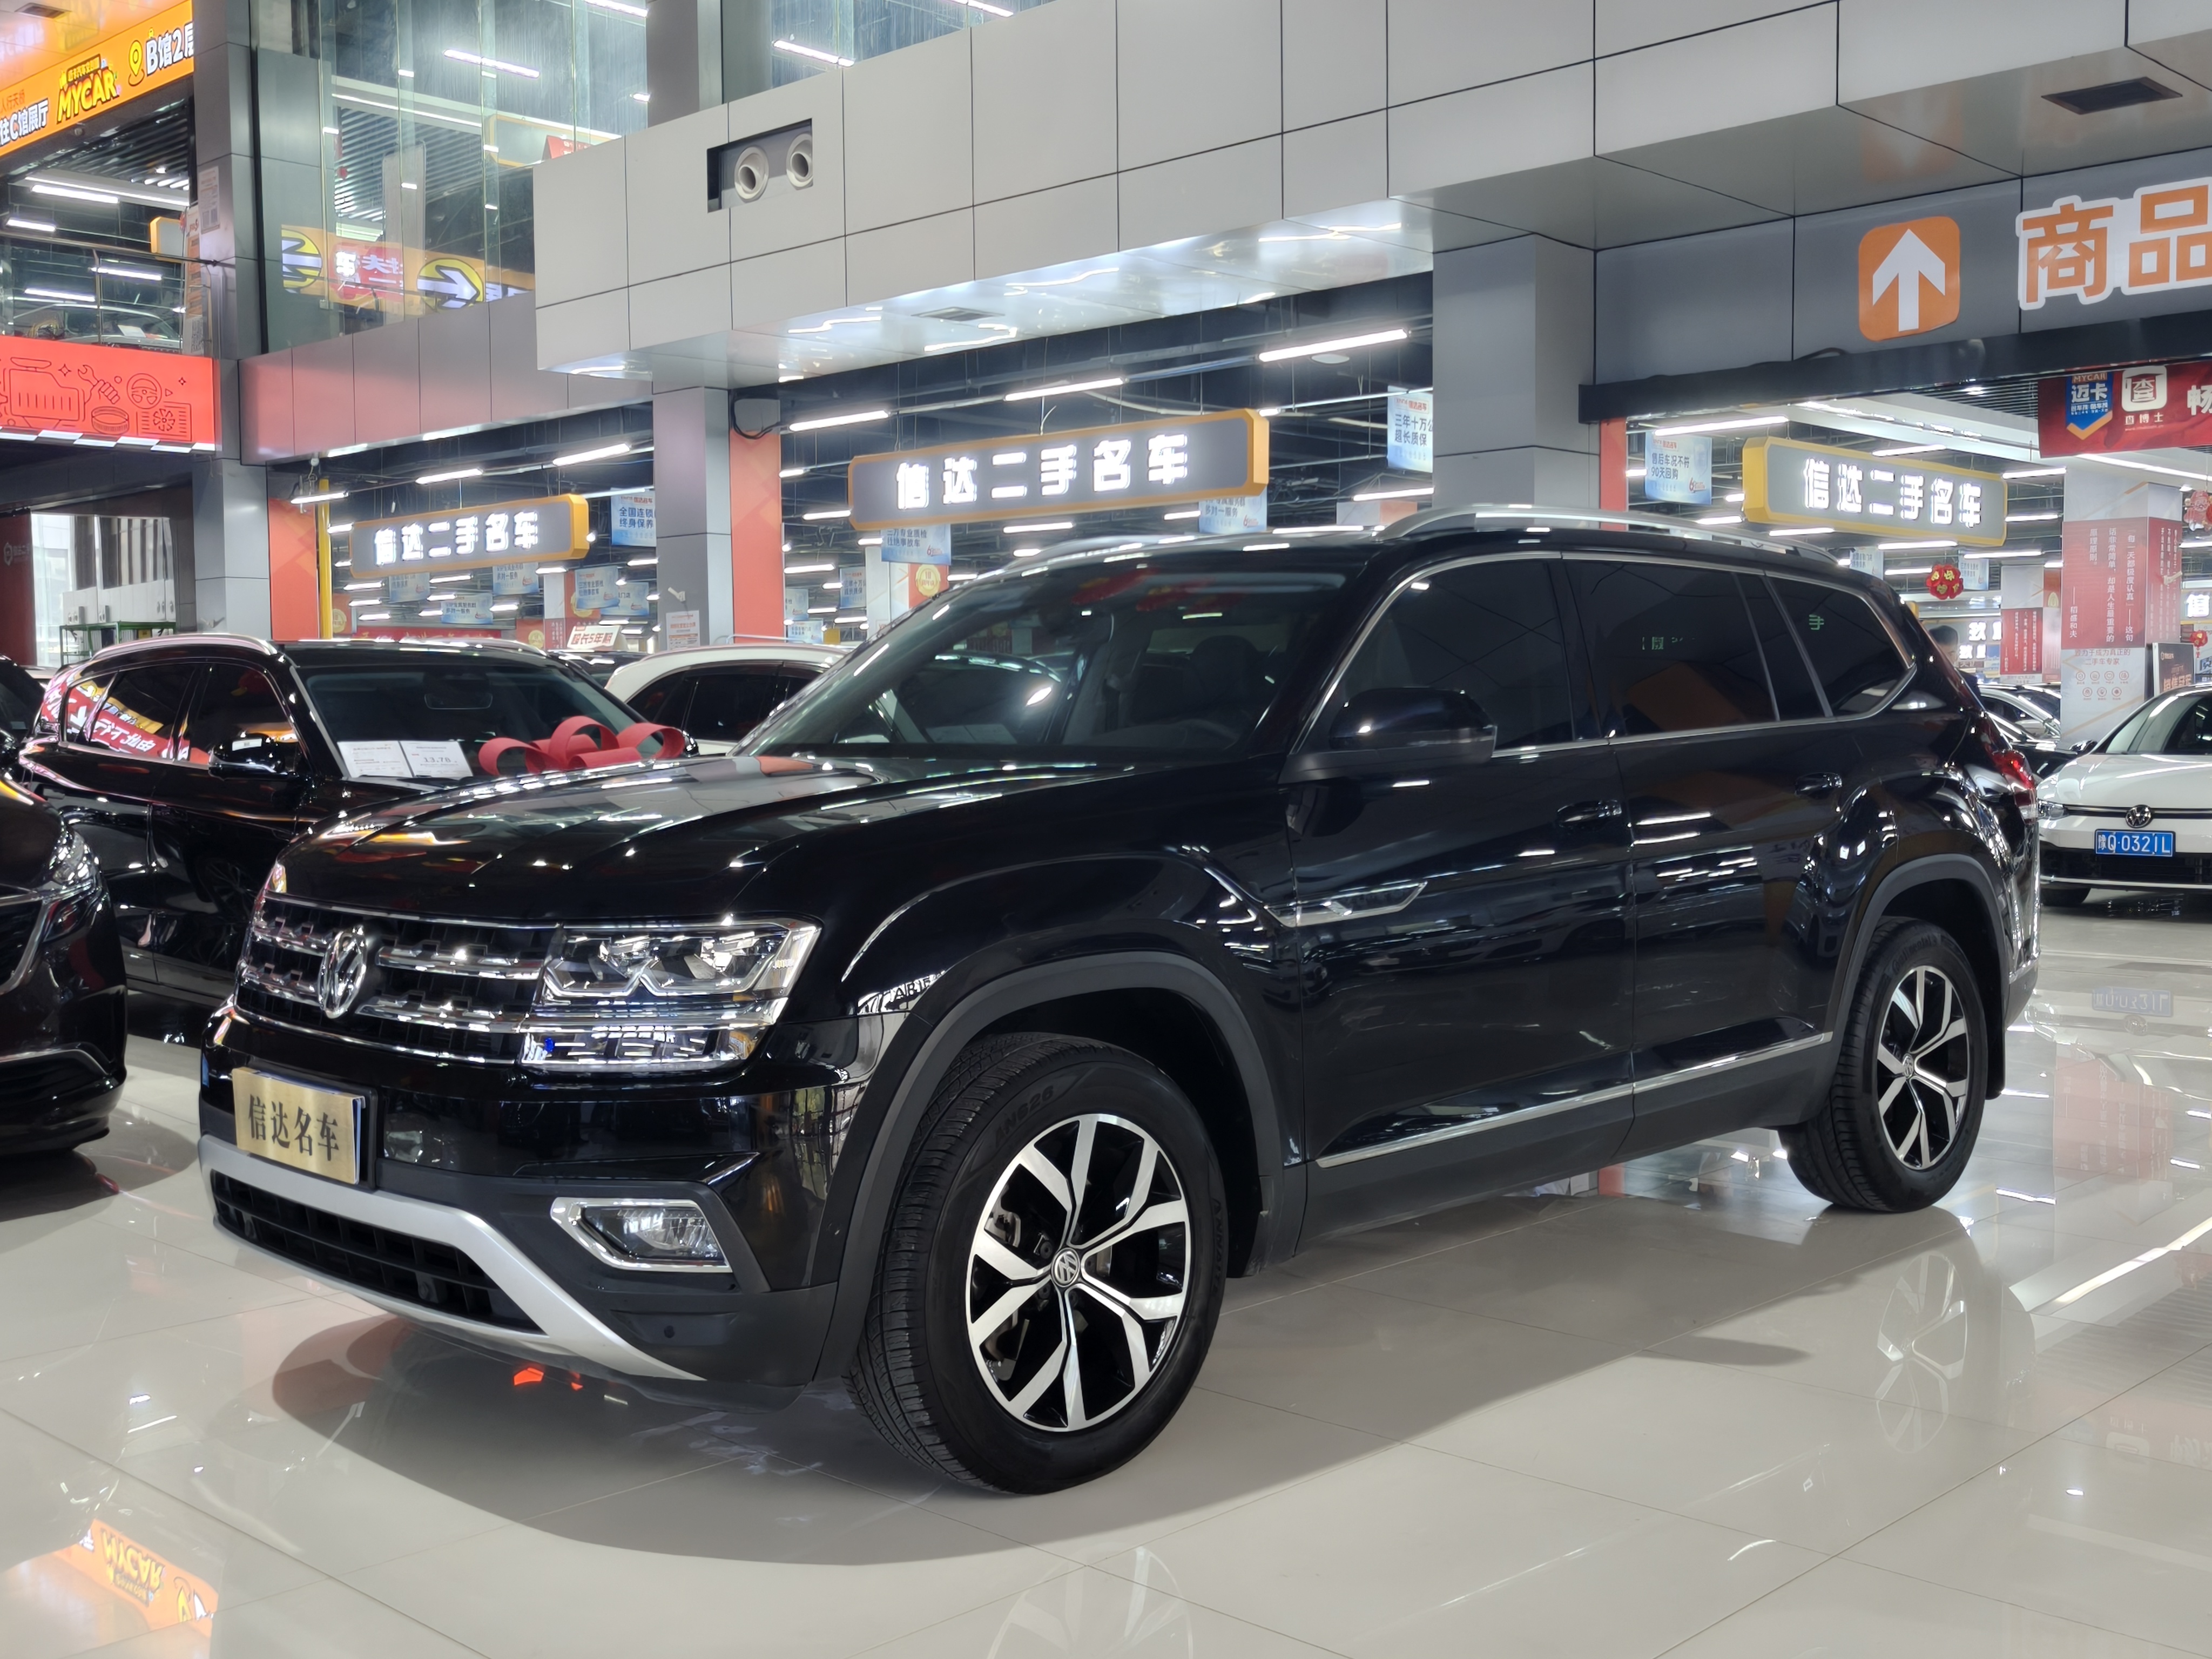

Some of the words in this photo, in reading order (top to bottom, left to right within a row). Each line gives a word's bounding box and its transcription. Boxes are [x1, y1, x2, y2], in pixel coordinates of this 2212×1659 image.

[57, 67, 120, 125] MYCAR
[2015, 176, 2212, 311] 商品
[2072, 383, 2108, 403] 迈卡
[896, 433, 1188, 510] 信达二手名车
[1650, 466, 1679, 480] 90天回购
[1651, 453, 1690, 469] 售后车况不符
[1803, 457, 1981, 528] 信达二手名车
[374, 510, 538, 567] 信达二手名车
[248, 1094, 340, 1162] 信达名车
